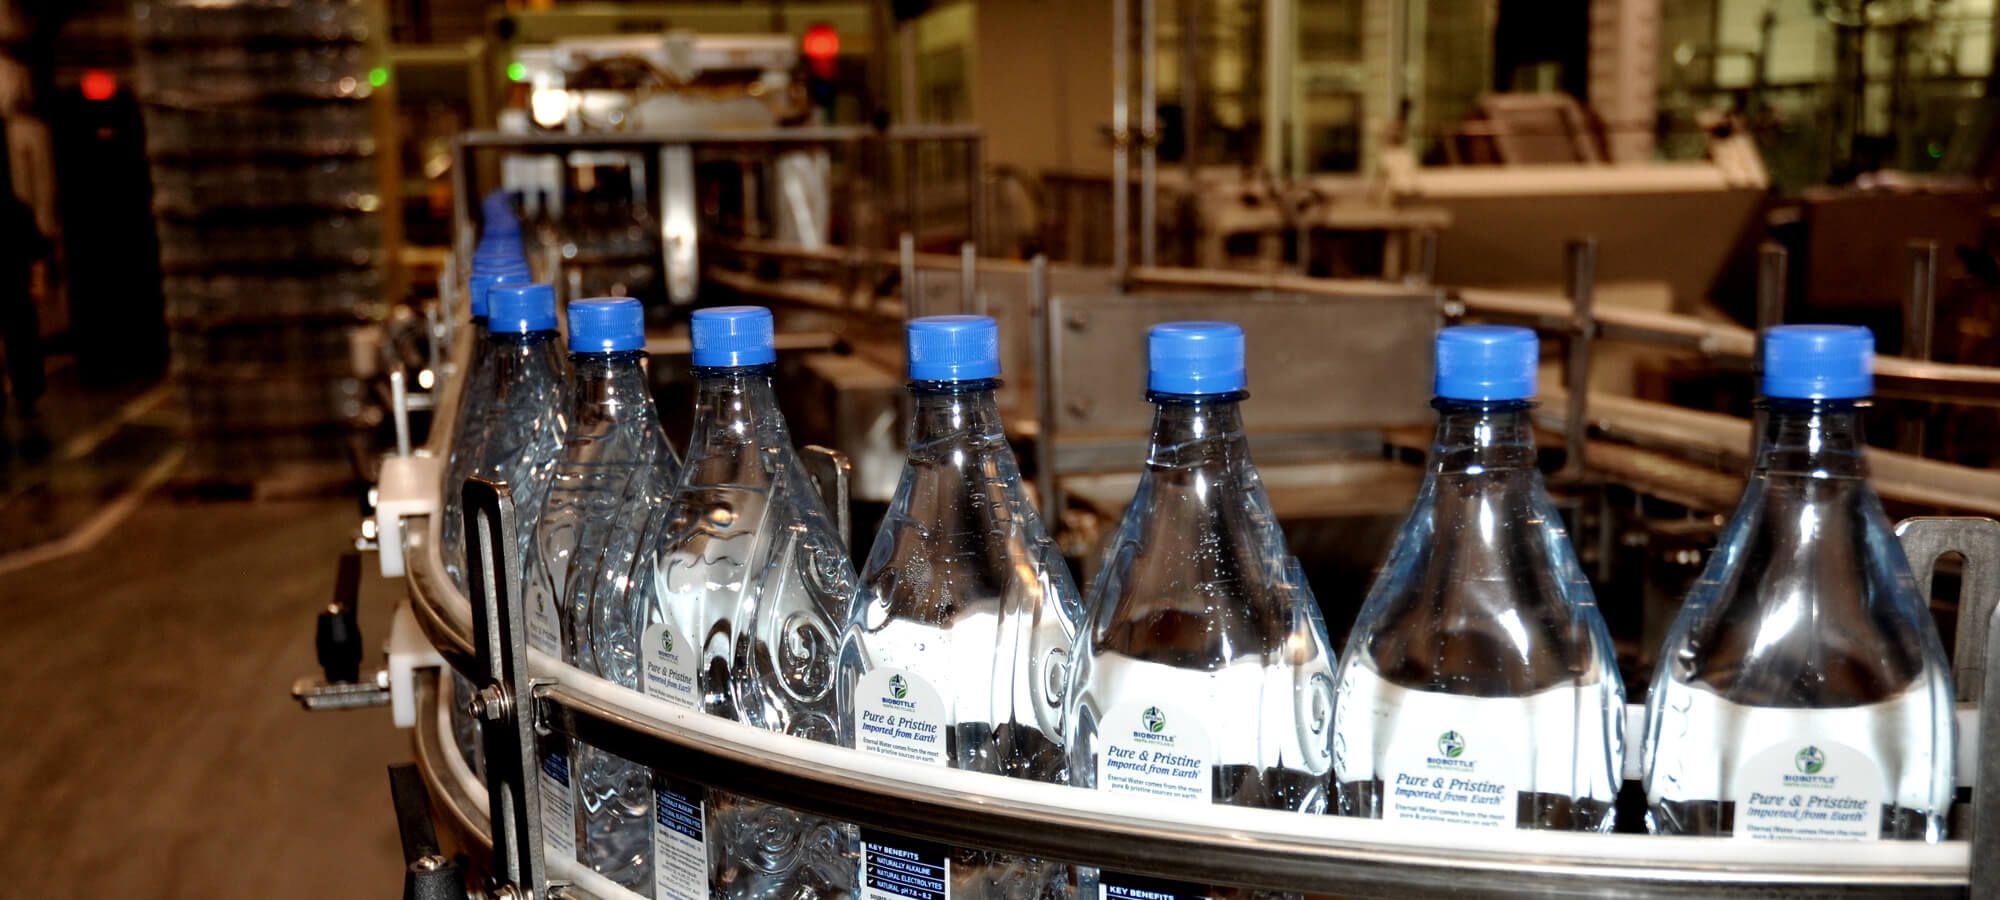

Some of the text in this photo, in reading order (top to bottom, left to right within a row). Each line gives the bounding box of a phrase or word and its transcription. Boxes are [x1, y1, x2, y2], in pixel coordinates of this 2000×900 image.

[648, 661, 660, 674] Pure
[662, 666, 667, 676] &
[669, 669, 692, 684] Pristine
[863, 710, 938, 733] Pure & Pristine
[862, 722, 936, 743] Imported from Earth
[1134, 731, 1174, 742] BIOBOTTLE
[1108, 745, 1201, 768] Pure & Pristine
[1107, 759, 1199, 779] Imported from Earth
[1396, 773, 1505, 794] Pure & Pristine
[1395, 787, 1501, 805] Imported from Earth
[1749, 792, 1868, 810] Pure & Pristine
[1746, 806, 1798, 818] Imported
[1796, 810, 1827, 821] from
[868, 843, 919, 860] KEY BENEFITS
[877, 857, 931, 875] NATURALLY ALKALINE
[877, 869, 943, 890] NATURAL ELECTROLYTES
[877, 880, 900, 892] NATURAL
[1110, 886, 1174, 900] KEY BENEFITS
